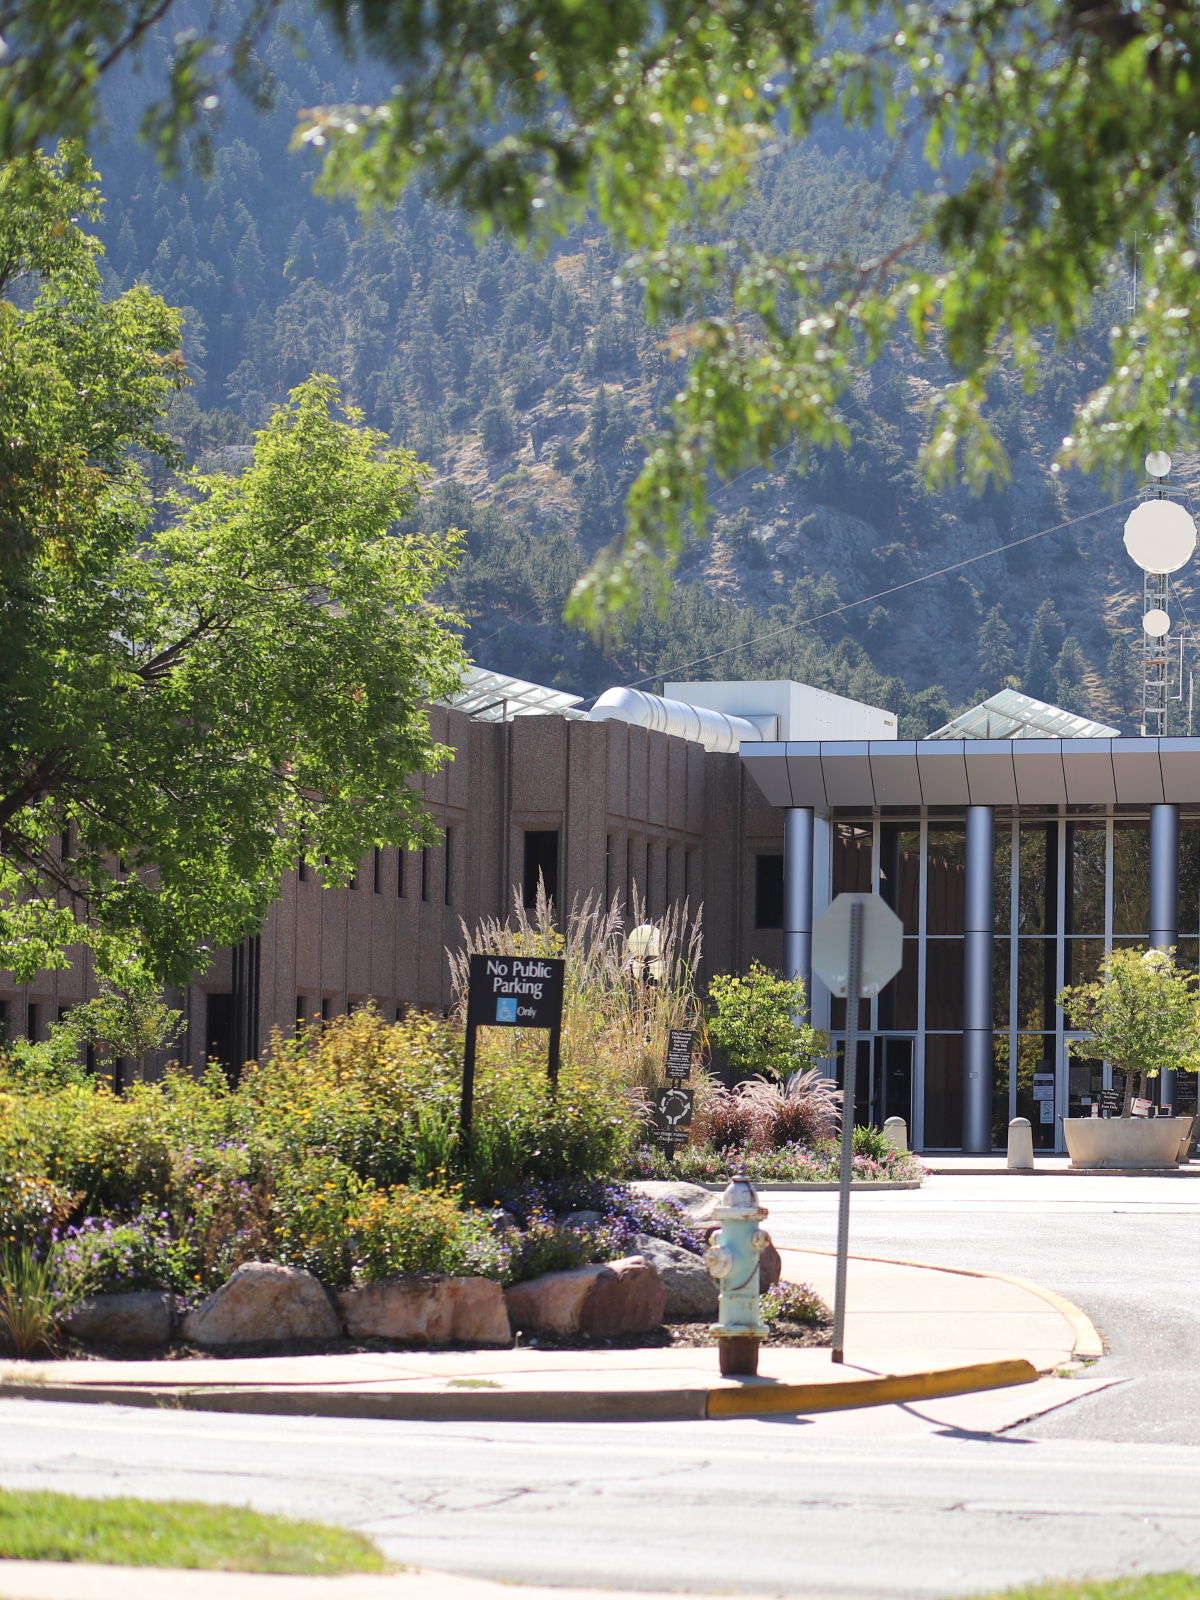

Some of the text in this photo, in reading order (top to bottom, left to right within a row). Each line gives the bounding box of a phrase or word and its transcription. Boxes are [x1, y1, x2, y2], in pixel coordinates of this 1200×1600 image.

[486, 960, 552, 978] No Public
[493, 977, 544, 1000] Parking
[516, 1006, 537, 1019] Only
